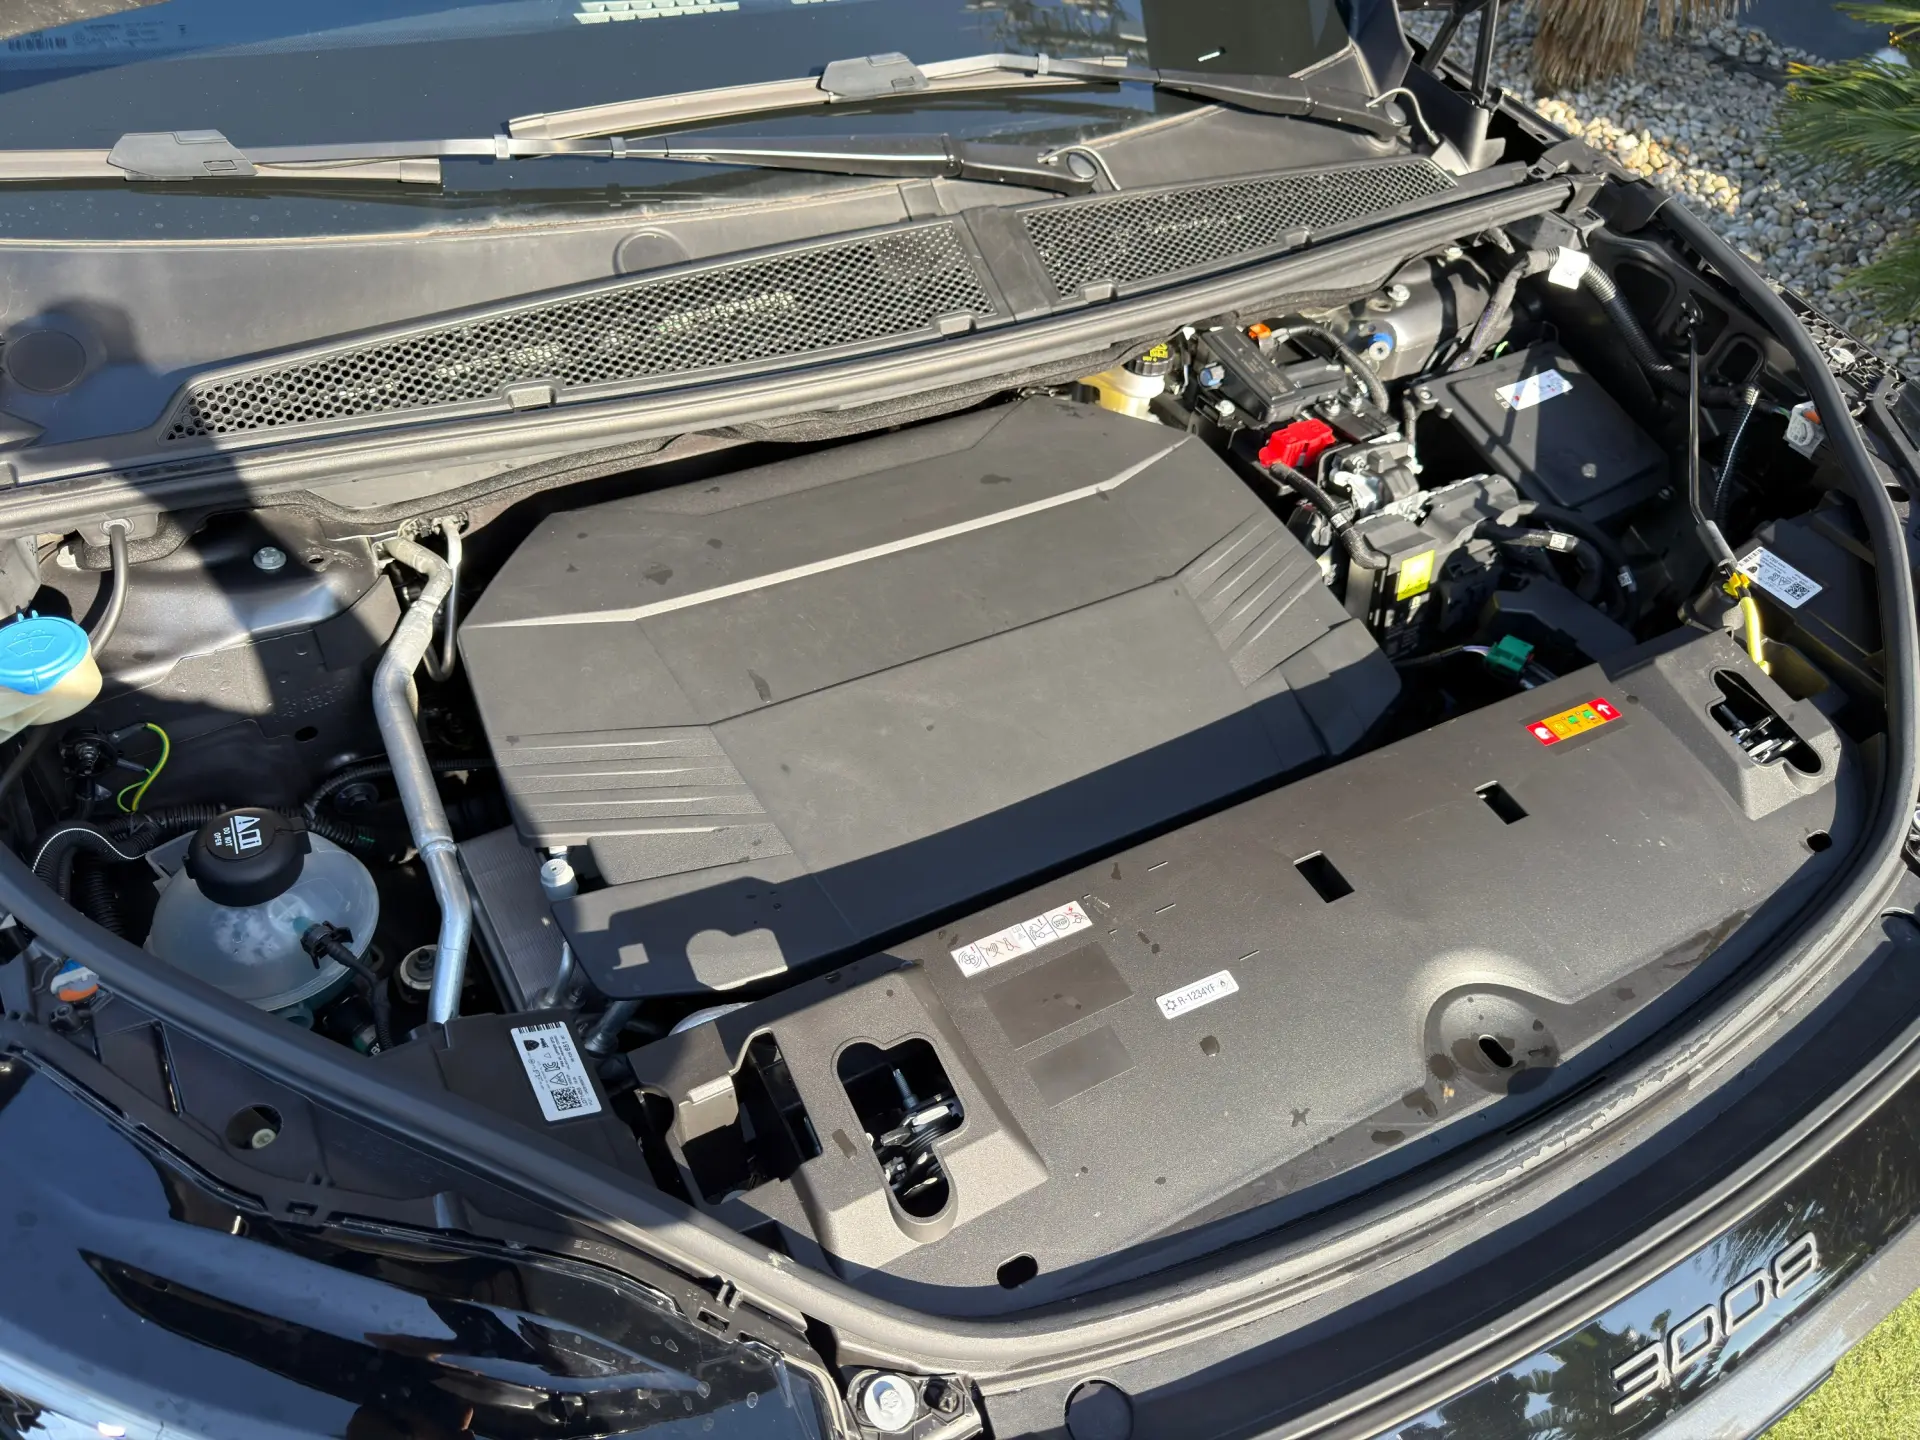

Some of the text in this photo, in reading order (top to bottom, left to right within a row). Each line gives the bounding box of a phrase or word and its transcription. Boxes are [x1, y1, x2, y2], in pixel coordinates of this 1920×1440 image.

[213, 832, 222, 846] OPEN
[223, 827, 233, 847] DO NOT
[1177, 983, 1216, 1006] R-1234YF
[1609, 1230, 1818, 1415] 3008
